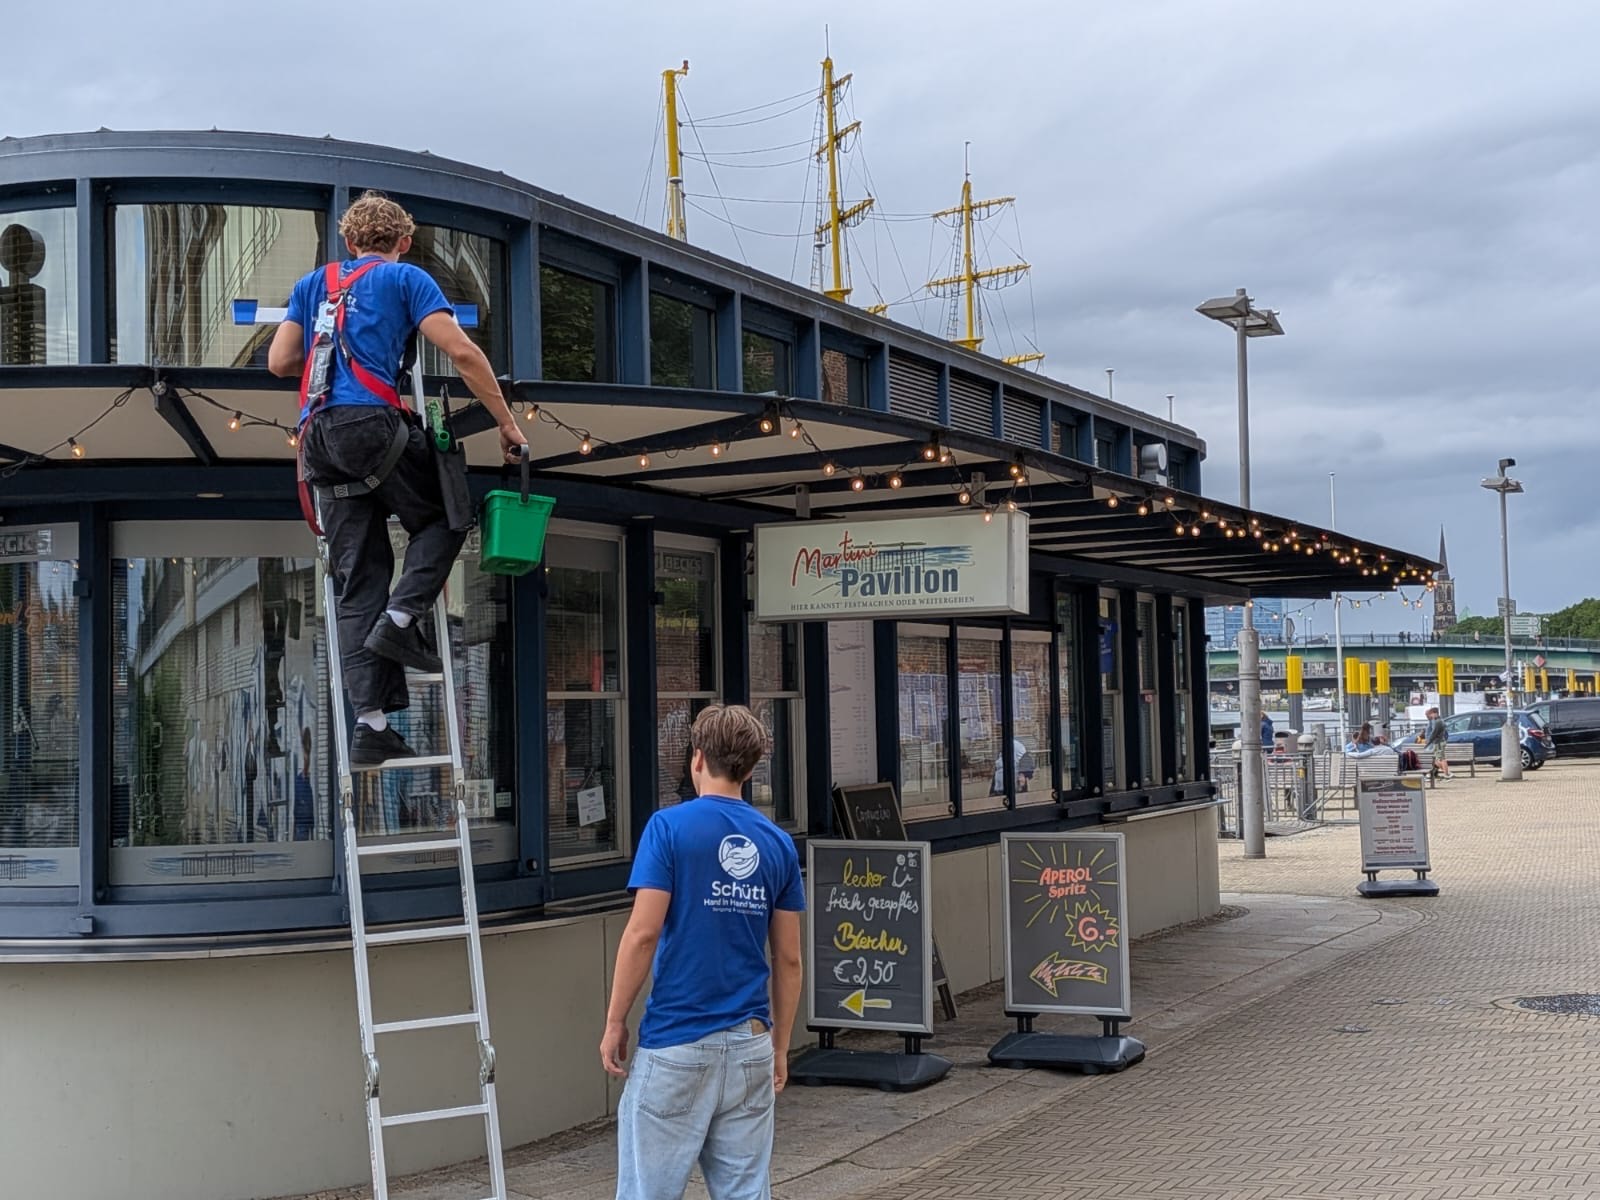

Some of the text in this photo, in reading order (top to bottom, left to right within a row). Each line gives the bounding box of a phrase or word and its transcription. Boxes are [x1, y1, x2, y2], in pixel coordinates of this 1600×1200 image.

[791, 530, 878, 587] Martini
[841, 565, 959, 597] Pavillon
[790, 602, 809, 611] HIER
[844, 599, 895, 609] FESTMACHEN
[896, 598, 917, 606] ODER
[918, 595, 975, 605] WEITERGEHEN
[843, 856, 888, 888] lecker
[1039, 867, 1093, 886] APEROL
[711, 880, 767, 901] Schütt
[826, 887, 919, 922] frisch gezapftes
[1048, 884, 1087, 899] Spritz
[833, 921, 908, 956] Bierchen
